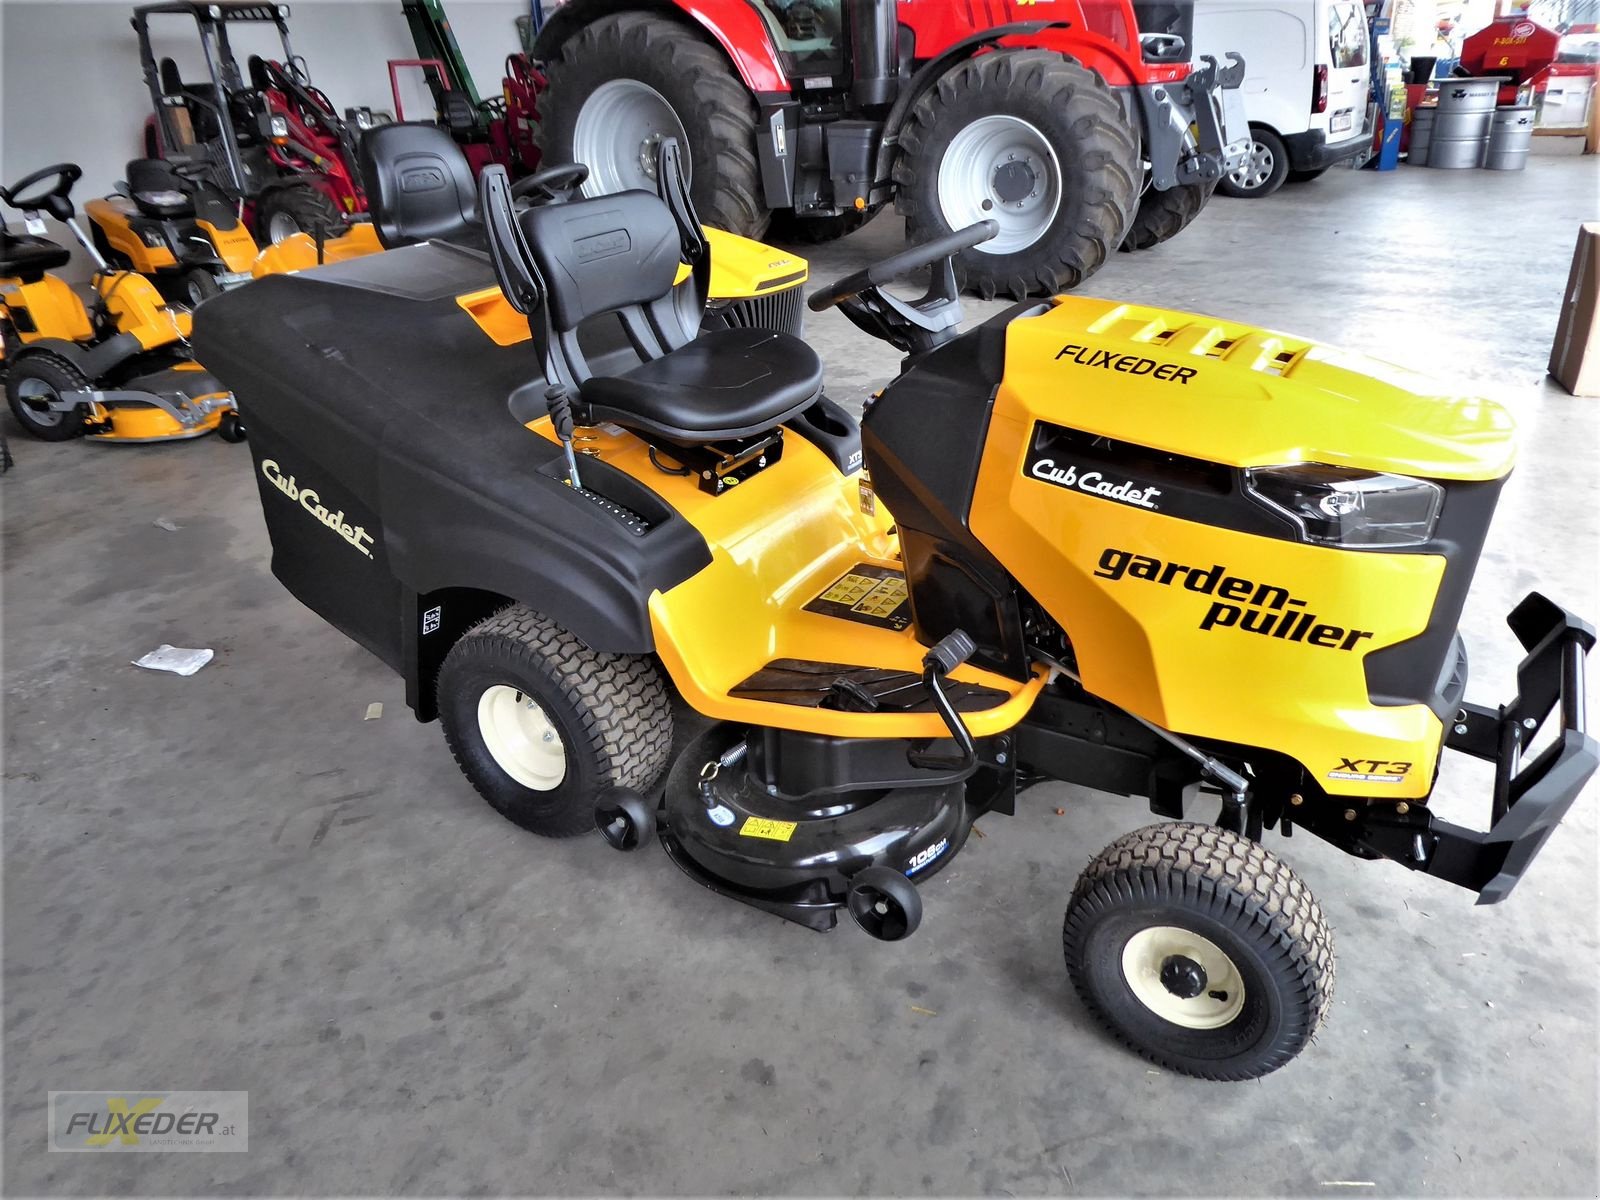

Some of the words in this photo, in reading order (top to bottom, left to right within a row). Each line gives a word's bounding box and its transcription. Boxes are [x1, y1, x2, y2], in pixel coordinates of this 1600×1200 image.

[1055, 344, 1198, 384] FLIXEDER
[262, 459, 299, 501] Cub
[300, 489, 374, 557] Cadet
[1032, 459, 1077, 485] Cub
[1078, 472, 1161, 508] Cadet
[1094, 548, 1308, 611] garden-
[1199, 601, 1374, 651] puller
[1333, 757, 1412, 774] XT3
